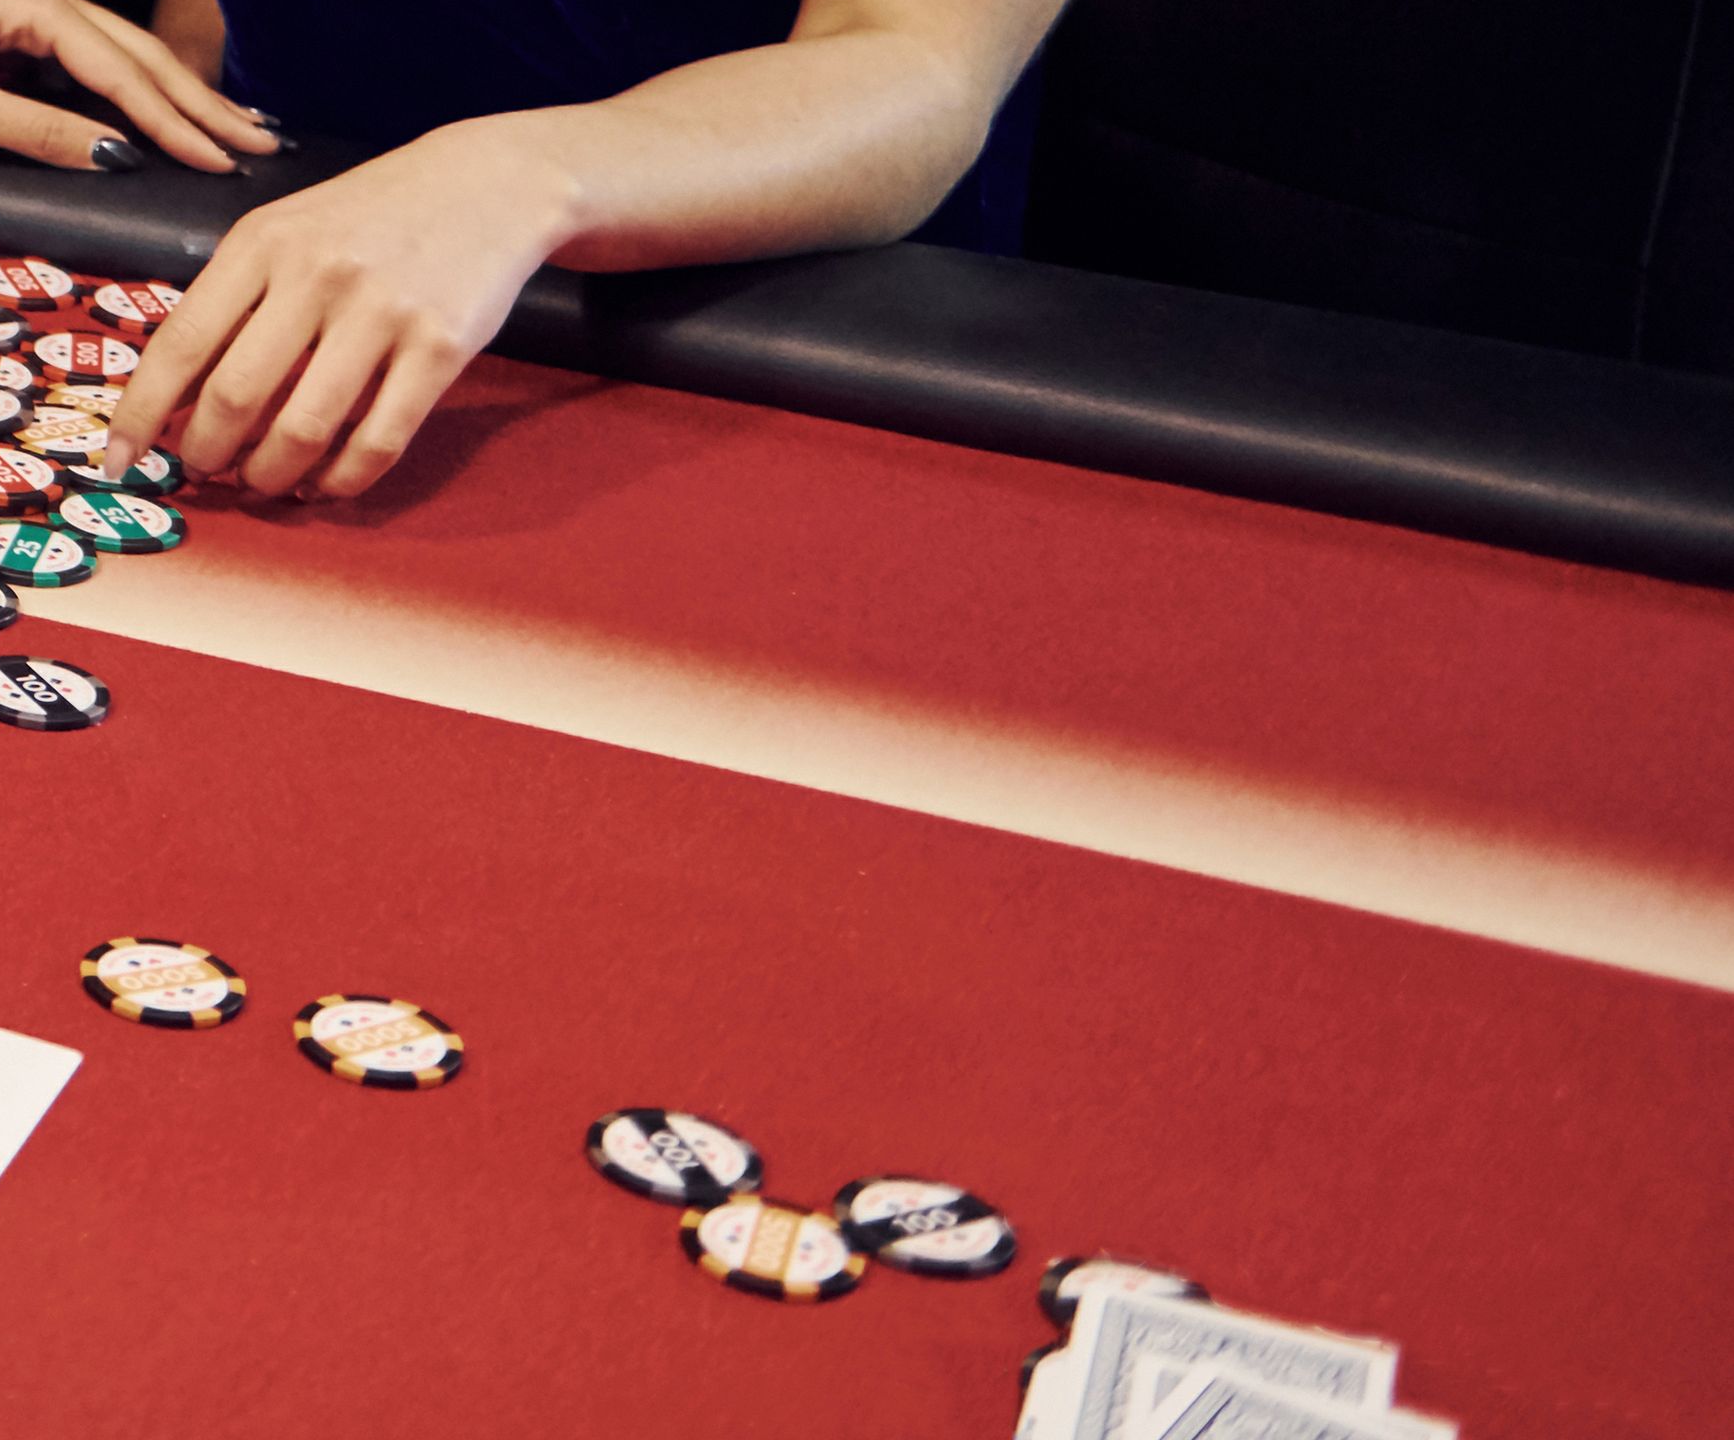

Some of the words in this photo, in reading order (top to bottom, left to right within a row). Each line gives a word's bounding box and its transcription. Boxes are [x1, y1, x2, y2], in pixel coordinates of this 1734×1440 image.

[8, 267, 39, 291] 500
[130, 290, 165, 315] 500
[76, 341, 100, 367] 500
[25, 418, 95, 439] 5000
[101, 506, 135, 525] 25
[13, 539, 42, 559] 25
[16, 674, 59, 703] 100
[118, 965, 206, 991] 5000
[336, 1021, 422, 1052] 5000
[650, 1130, 699, 1170] 100
[892, 1208, 958, 1233] 100
